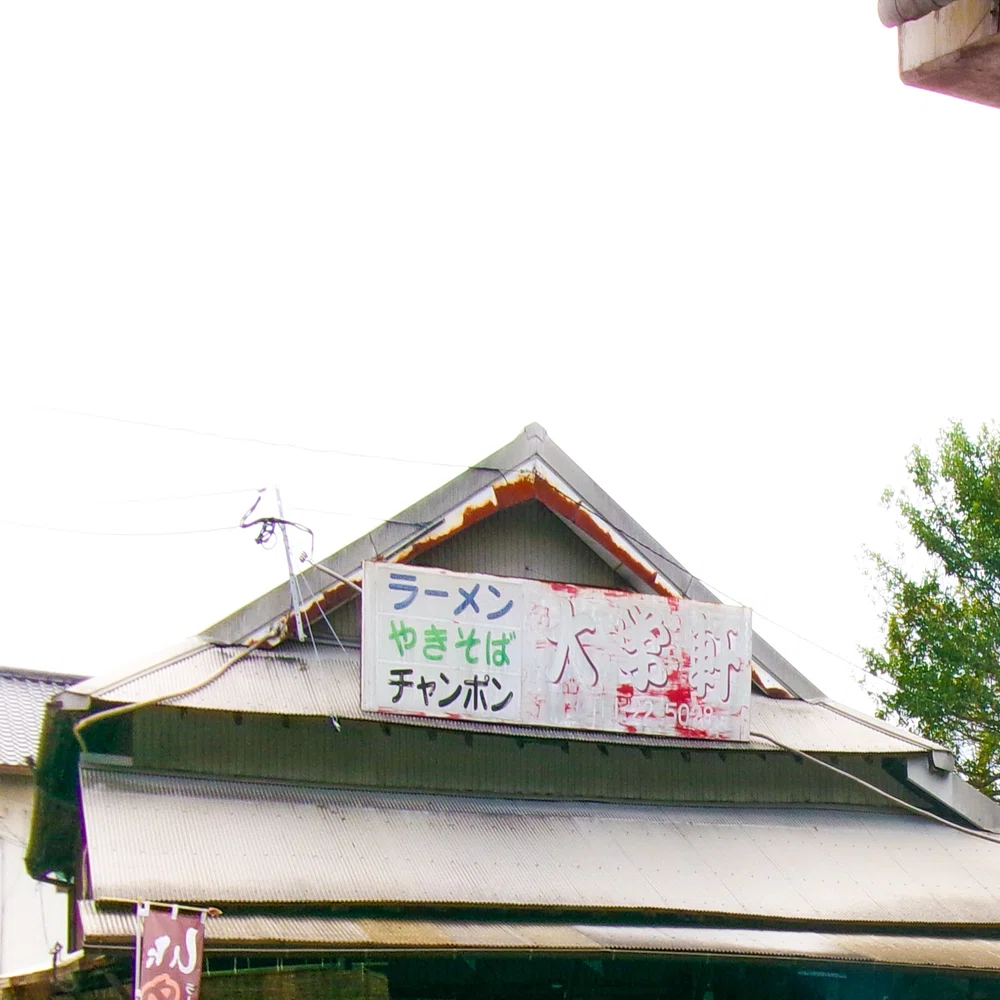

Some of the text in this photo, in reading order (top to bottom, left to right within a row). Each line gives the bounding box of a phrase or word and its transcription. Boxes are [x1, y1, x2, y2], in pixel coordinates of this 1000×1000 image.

[388, 572, 514, 620] ラーメン
[388, 619, 517, 667] やきそば
[387, 668, 514, 712] チャンポン
